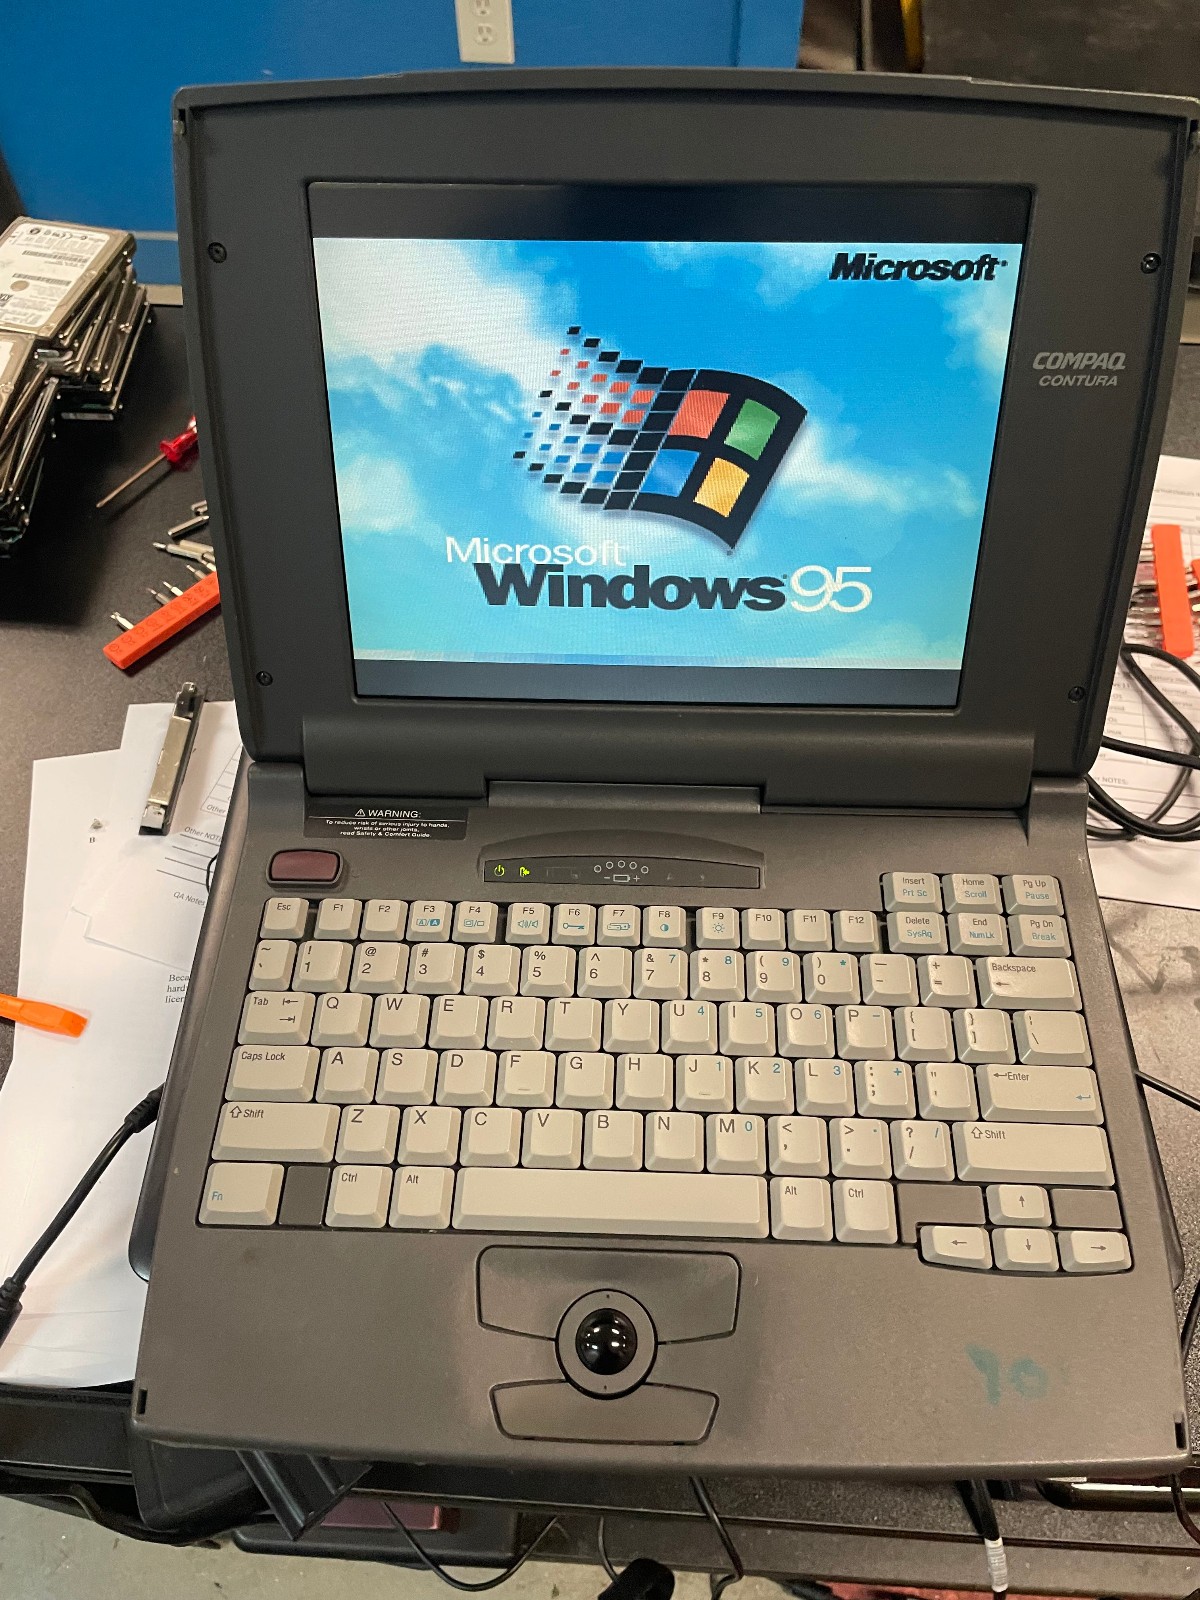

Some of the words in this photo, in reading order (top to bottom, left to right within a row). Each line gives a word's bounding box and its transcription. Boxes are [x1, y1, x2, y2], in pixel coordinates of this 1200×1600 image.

[829, 253, 1000, 280] Microsoft
[1032, 352, 1126, 370] COMPAQ
[1038, 375, 1117, 386] CONTURA
[446, 536, 627, 567] Microsoft
[473, 562, 786, 611] Windows
[788, 565, 872, 613] 95
[184, 826, 204, 837] Other
[902, 877, 925, 885] Insert
[962, 878, 985, 886] Home
[1022, 879, 1033, 888] Pg
[1035, 880, 1047, 888] Up
[174, 891, 185, 899] QA
[902, 888, 915, 897] Prt
[917, 889, 928, 897] Sc
[964, 890, 987, 898] Scroll
[1025, 892, 1049, 900] Pause
[276, 902, 292, 911] Esc
[333, 904, 344, 912] F1
[378, 905, 391, 913] F2
[423, 905, 436, 913] F3
[468, 906, 481, 914] F4
[522, 907, 535, 915] F5
[568, 908, 581, 916] F6
[612, 909, 625, 917] F7
[658, 910, 671, 918] F8
[712, 912, 725, 920] F9
[755, 913, 772, 922] F10
[803, 915, 817, 923] F11
[848, 916, 865, 924] F12
[905, 916, 930, 925] Delete
[972, 918, 988, 926] End
[1030, 919, 1041, 929] Pg
[1043, 920, 1054, 928] Dn
[906, 929, 933, 939] SysRq
[969, 931, 995, 939] NumLk
[1032, 933, 1057, 941] Break
[307, 945, 312, 955] !
[365, 946, 377, 957] @
[421, 947, 429, 958] #
[477, 949, 485, 960] $
[534, 950, 546, 961] %
[646, 953, 655, 963] &
[668, 954, 676, 964] 7
[724, 955, 733, 965] 8
[759, 955, 764, 967] (
[782, 957, 790, 967] 9
[817, 956, 822, 968] )
[304, 962, 311, 973] 1
[361, 963, 372, 974] 2
[418, 964, 428, 975] 3
[932, 961, 940, 970] +
[991, 962, 1036, 974] Backspace
[475, 966, 485, 977] 4
[532, 966, 542, 978] 5
[589, 968, 598, 979] 6
[646, 969, 655, 981] 7
[702, 971, 711, 982] 8
[759, 972, 768, 984] 9
[817, 974, 826, 985] 0
[253, 997, 269, 1006] Tab
[326, 996, 339, 1010] Q
[386, 997, 403, 1011] W
[443, 998, 455, 1012] E
[501, 1000, 513, 1014] R
[559, 1001, 571, 1015] T
[617, 1002, 629, 1016] Y
[673, 1003, 685, 1017] U
[697, 1006, 705, 1015] 4
[755, 1008, 763, 1018] 5
[790, 1007, 803, 1020] O
[814, 1010, 822, 1020] 6
[848, 1009, 859, 1022] P
[910, 1011, 915, 1024] {
[969, 1012, 974, 1025] }
[911, 1028, 917, 1042] [
[972, 1031, 977, 1044] ]
[1031, 1032, 1039, 1045] \
[241, 1051, 263, 1061] Caps
[265, 1052, 285, 1061] Lock
[331, 1051, 344, 1065] A
[391, 1052, 403, 1066] S
[450, 1054, 464, 1068] D
[510, 1055, 522, 1068] F
[569, 1056, 583, 1070] G
[628, 1057, 641, 1071] H
[689, 1059, 698, 1073] J
[716, 1061, 721, 1072] 1
[748, 1060, 760, 1075] K
[772, 1063, 781, 1074] 2
[808, 1062, 819, 1077] L
[833, 1065, 841, 1076] 3
[893, 1067, 902, 1076] +
[1007, 1072, 1030, 1081] Enter
[243, 1109, 264, 1119] Shift
[351, 1109, 365, 1124] Z
[414, 1110, 428, 1125] X
[474, 1111, 488, 1126] C
[537, 1113, 550, 1128] V
[597, 1114, 610, 1129] B
[657, 1116, 670, 1131] N
[719, 1118, 735, 1134] M
[744, 1121, 753, 1132] 0
[782, 1123, 793, 1134] <
[843, 1125, 855, 1135] >
[905, 1126, 913, 1138] ?
[984, 1129, 1006, 1139] Shift
[908, 1145, 915, 1160] /
[341, 1172, 358, 1183] Ctrl
[406, 1174, 419, 1184] Alt
[211, 1191, 224, 1201] Fn
[784, 1185, 798, 1196] Alt
[848, 1187, 864, 1199] Ctrl
